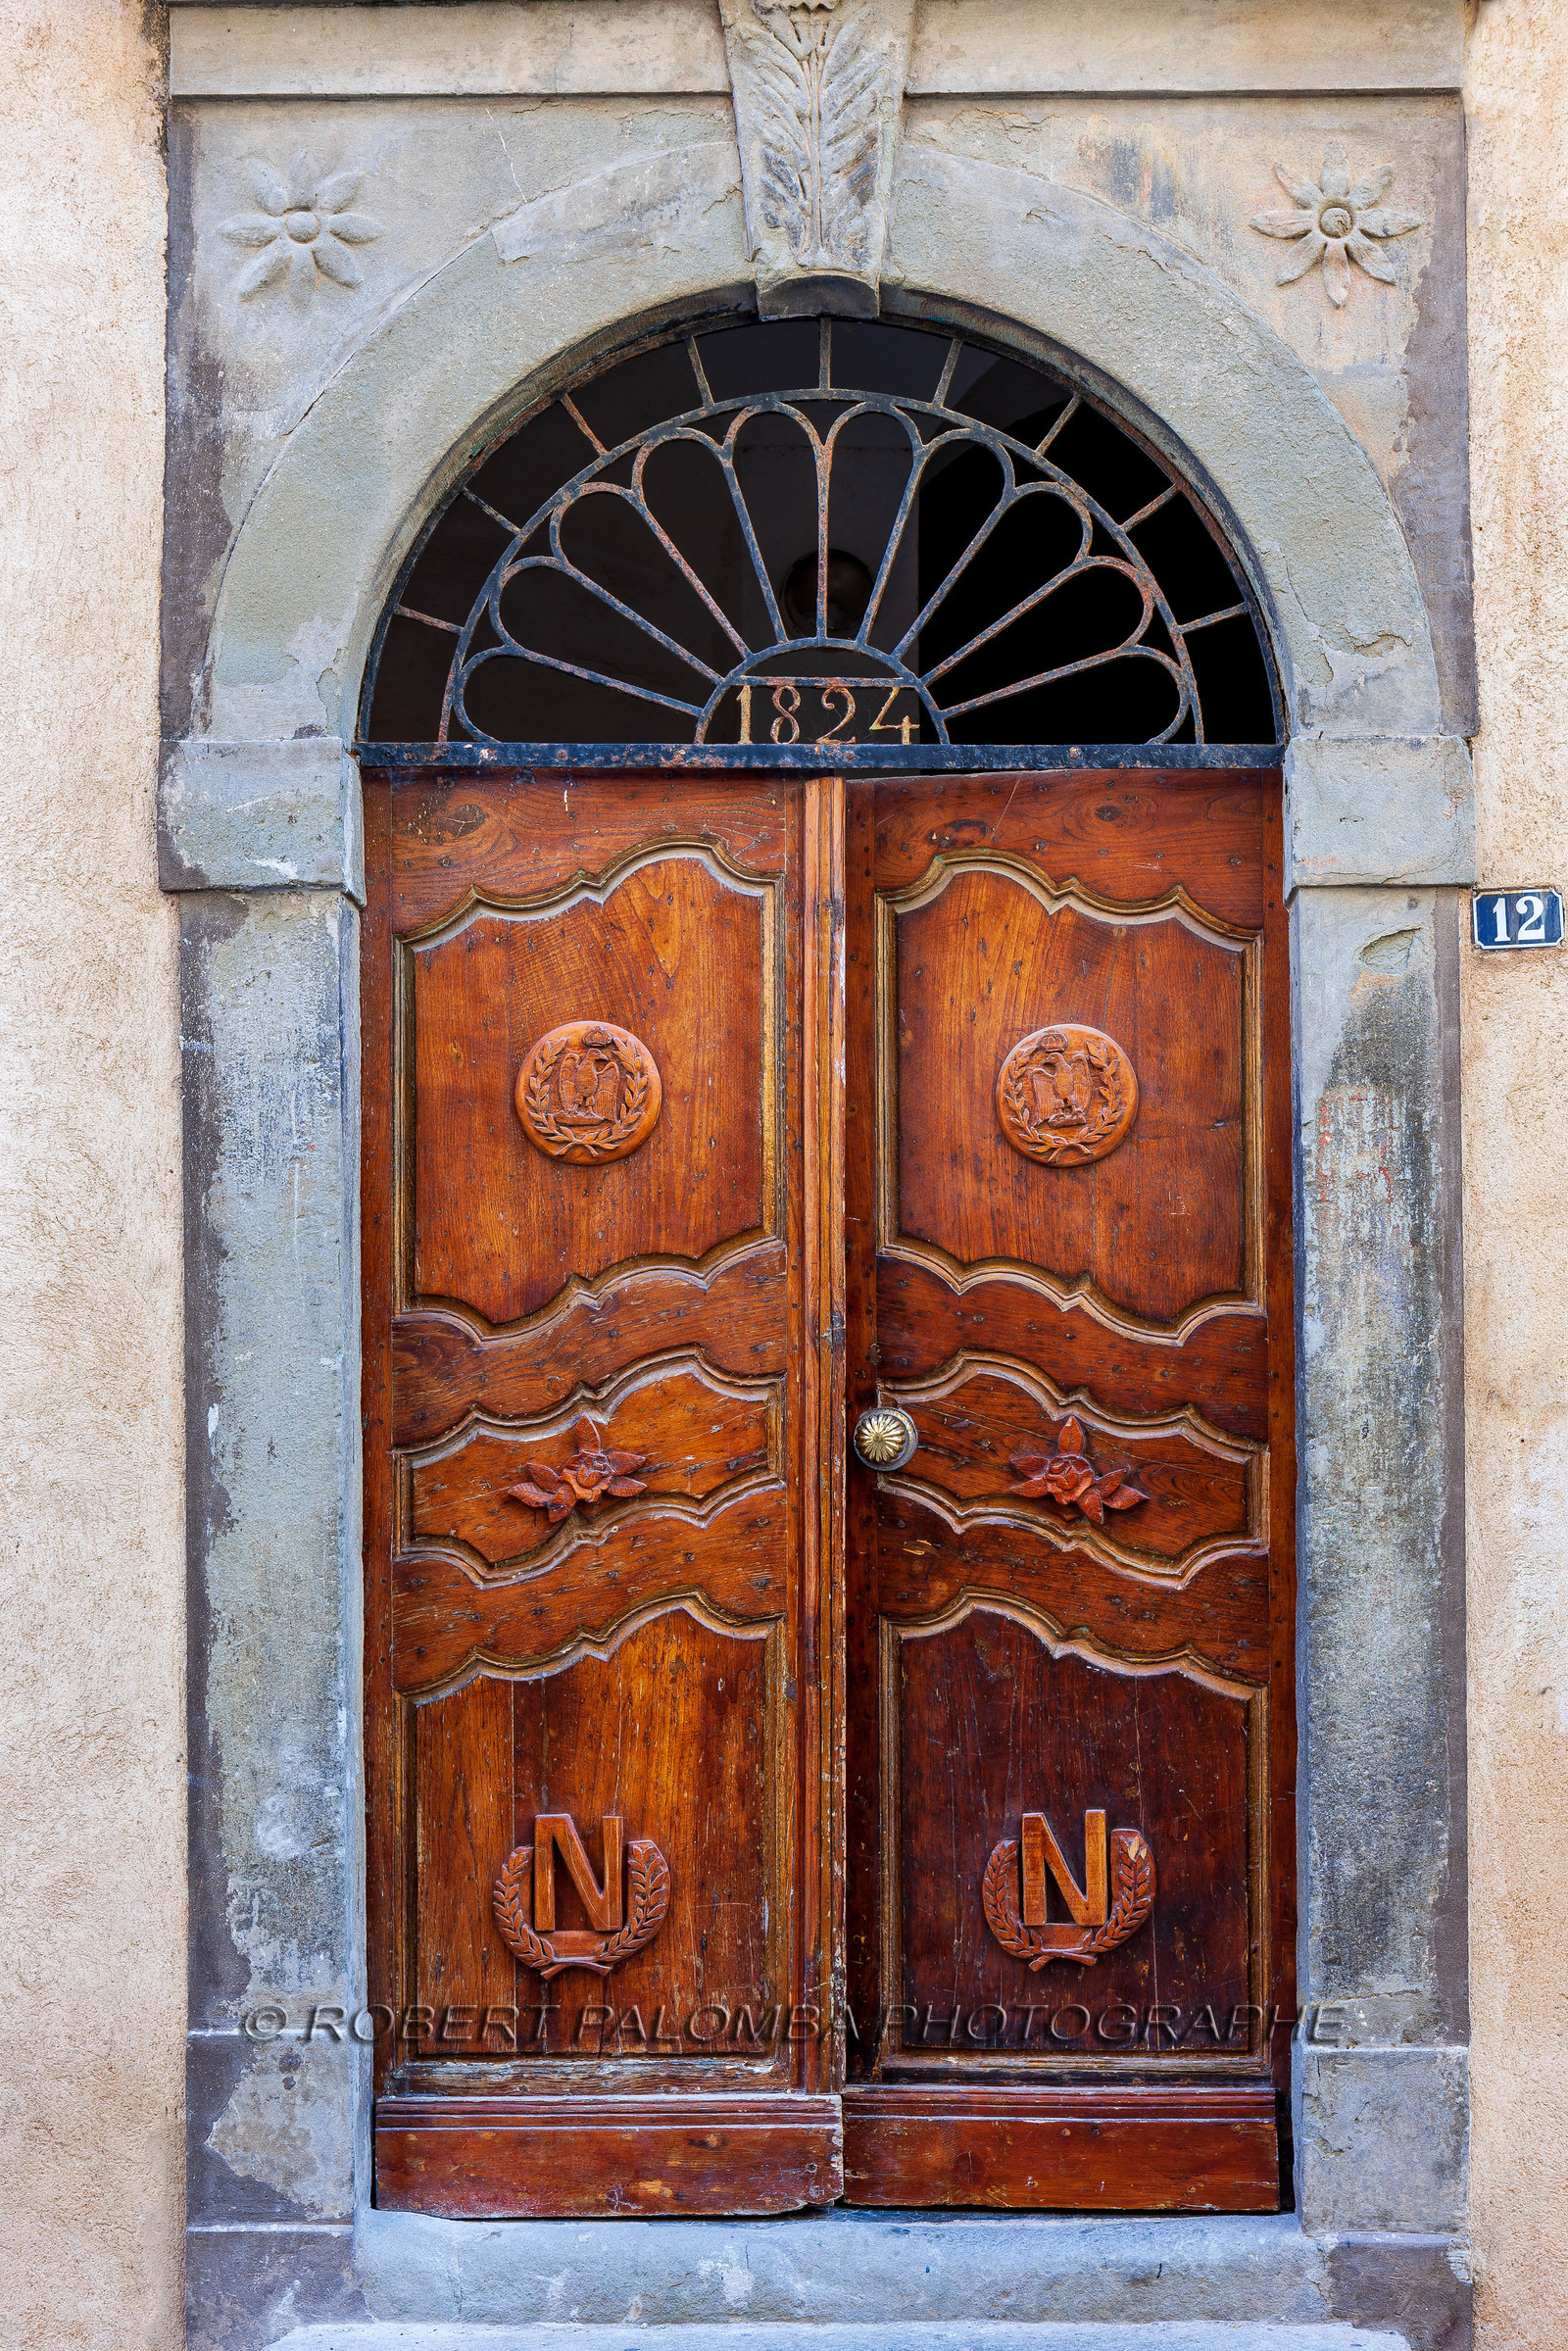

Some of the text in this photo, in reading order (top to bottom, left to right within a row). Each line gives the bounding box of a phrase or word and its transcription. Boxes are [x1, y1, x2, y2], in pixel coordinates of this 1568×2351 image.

[736, 684, 921, 745] 1824
[1493, 896, 1545, 942] 12
[534, 1813, 623, 1932] N
[1021, 1809, 1106, 1927] N
